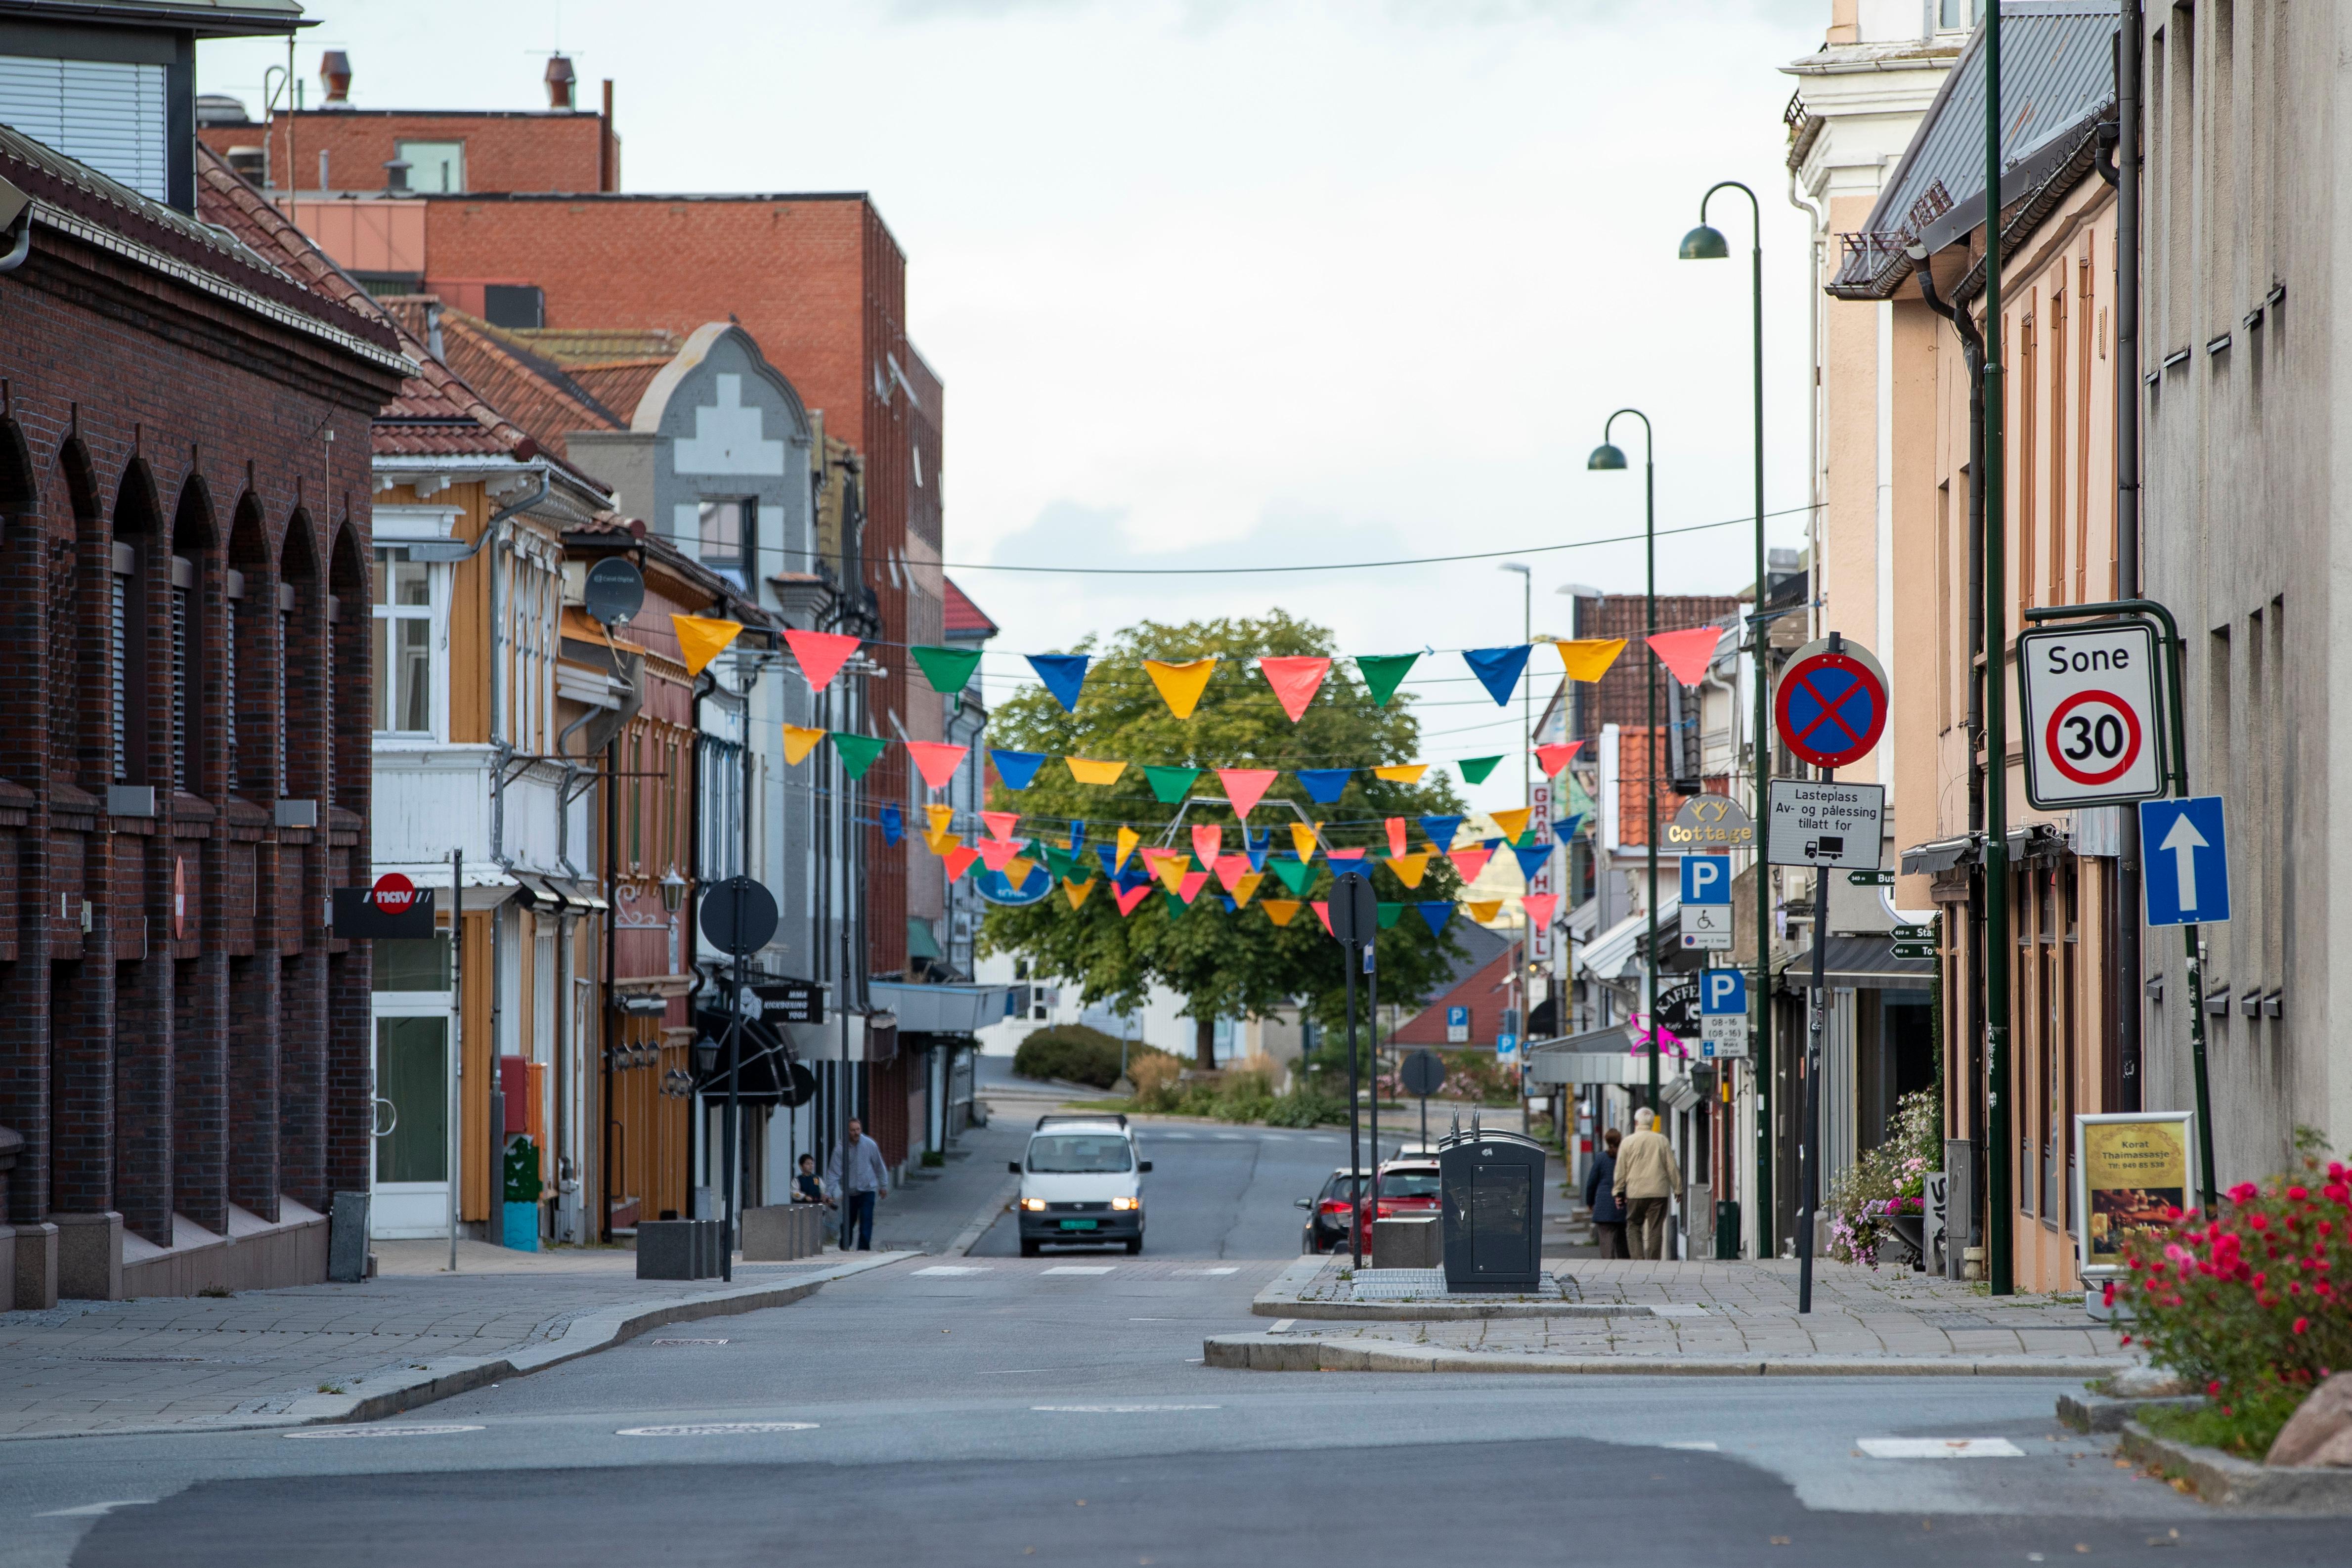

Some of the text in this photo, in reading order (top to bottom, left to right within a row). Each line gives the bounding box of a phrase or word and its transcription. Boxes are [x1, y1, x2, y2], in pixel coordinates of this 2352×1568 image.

[2049, 646, 2129, 674] Sone
[2064, 714, 2124, 761] 30
[1795, 789, 1858, 803] Lasteplass
[1776, 802, 1876, 820] Av- og pålessing
[1799, 818, 1852, 830] tillatt for
[1668, 825, 1752, 844] Cottage
[1693, 862, 1719, 899] P
[1878, 874, 1895, 882] Bus
[376, 891, 412, 903] nav
[1534, 875, 1548, 955] HEL
[788, 990, 808, 999] MMA
[1711, 975, 1735, 1009] P
[764, 1000, 808, 1009] KICKBOXING
[1451, 1007, 1463, 1025] P
[2102, 1151, 2170, 1159] Thaimassasje
